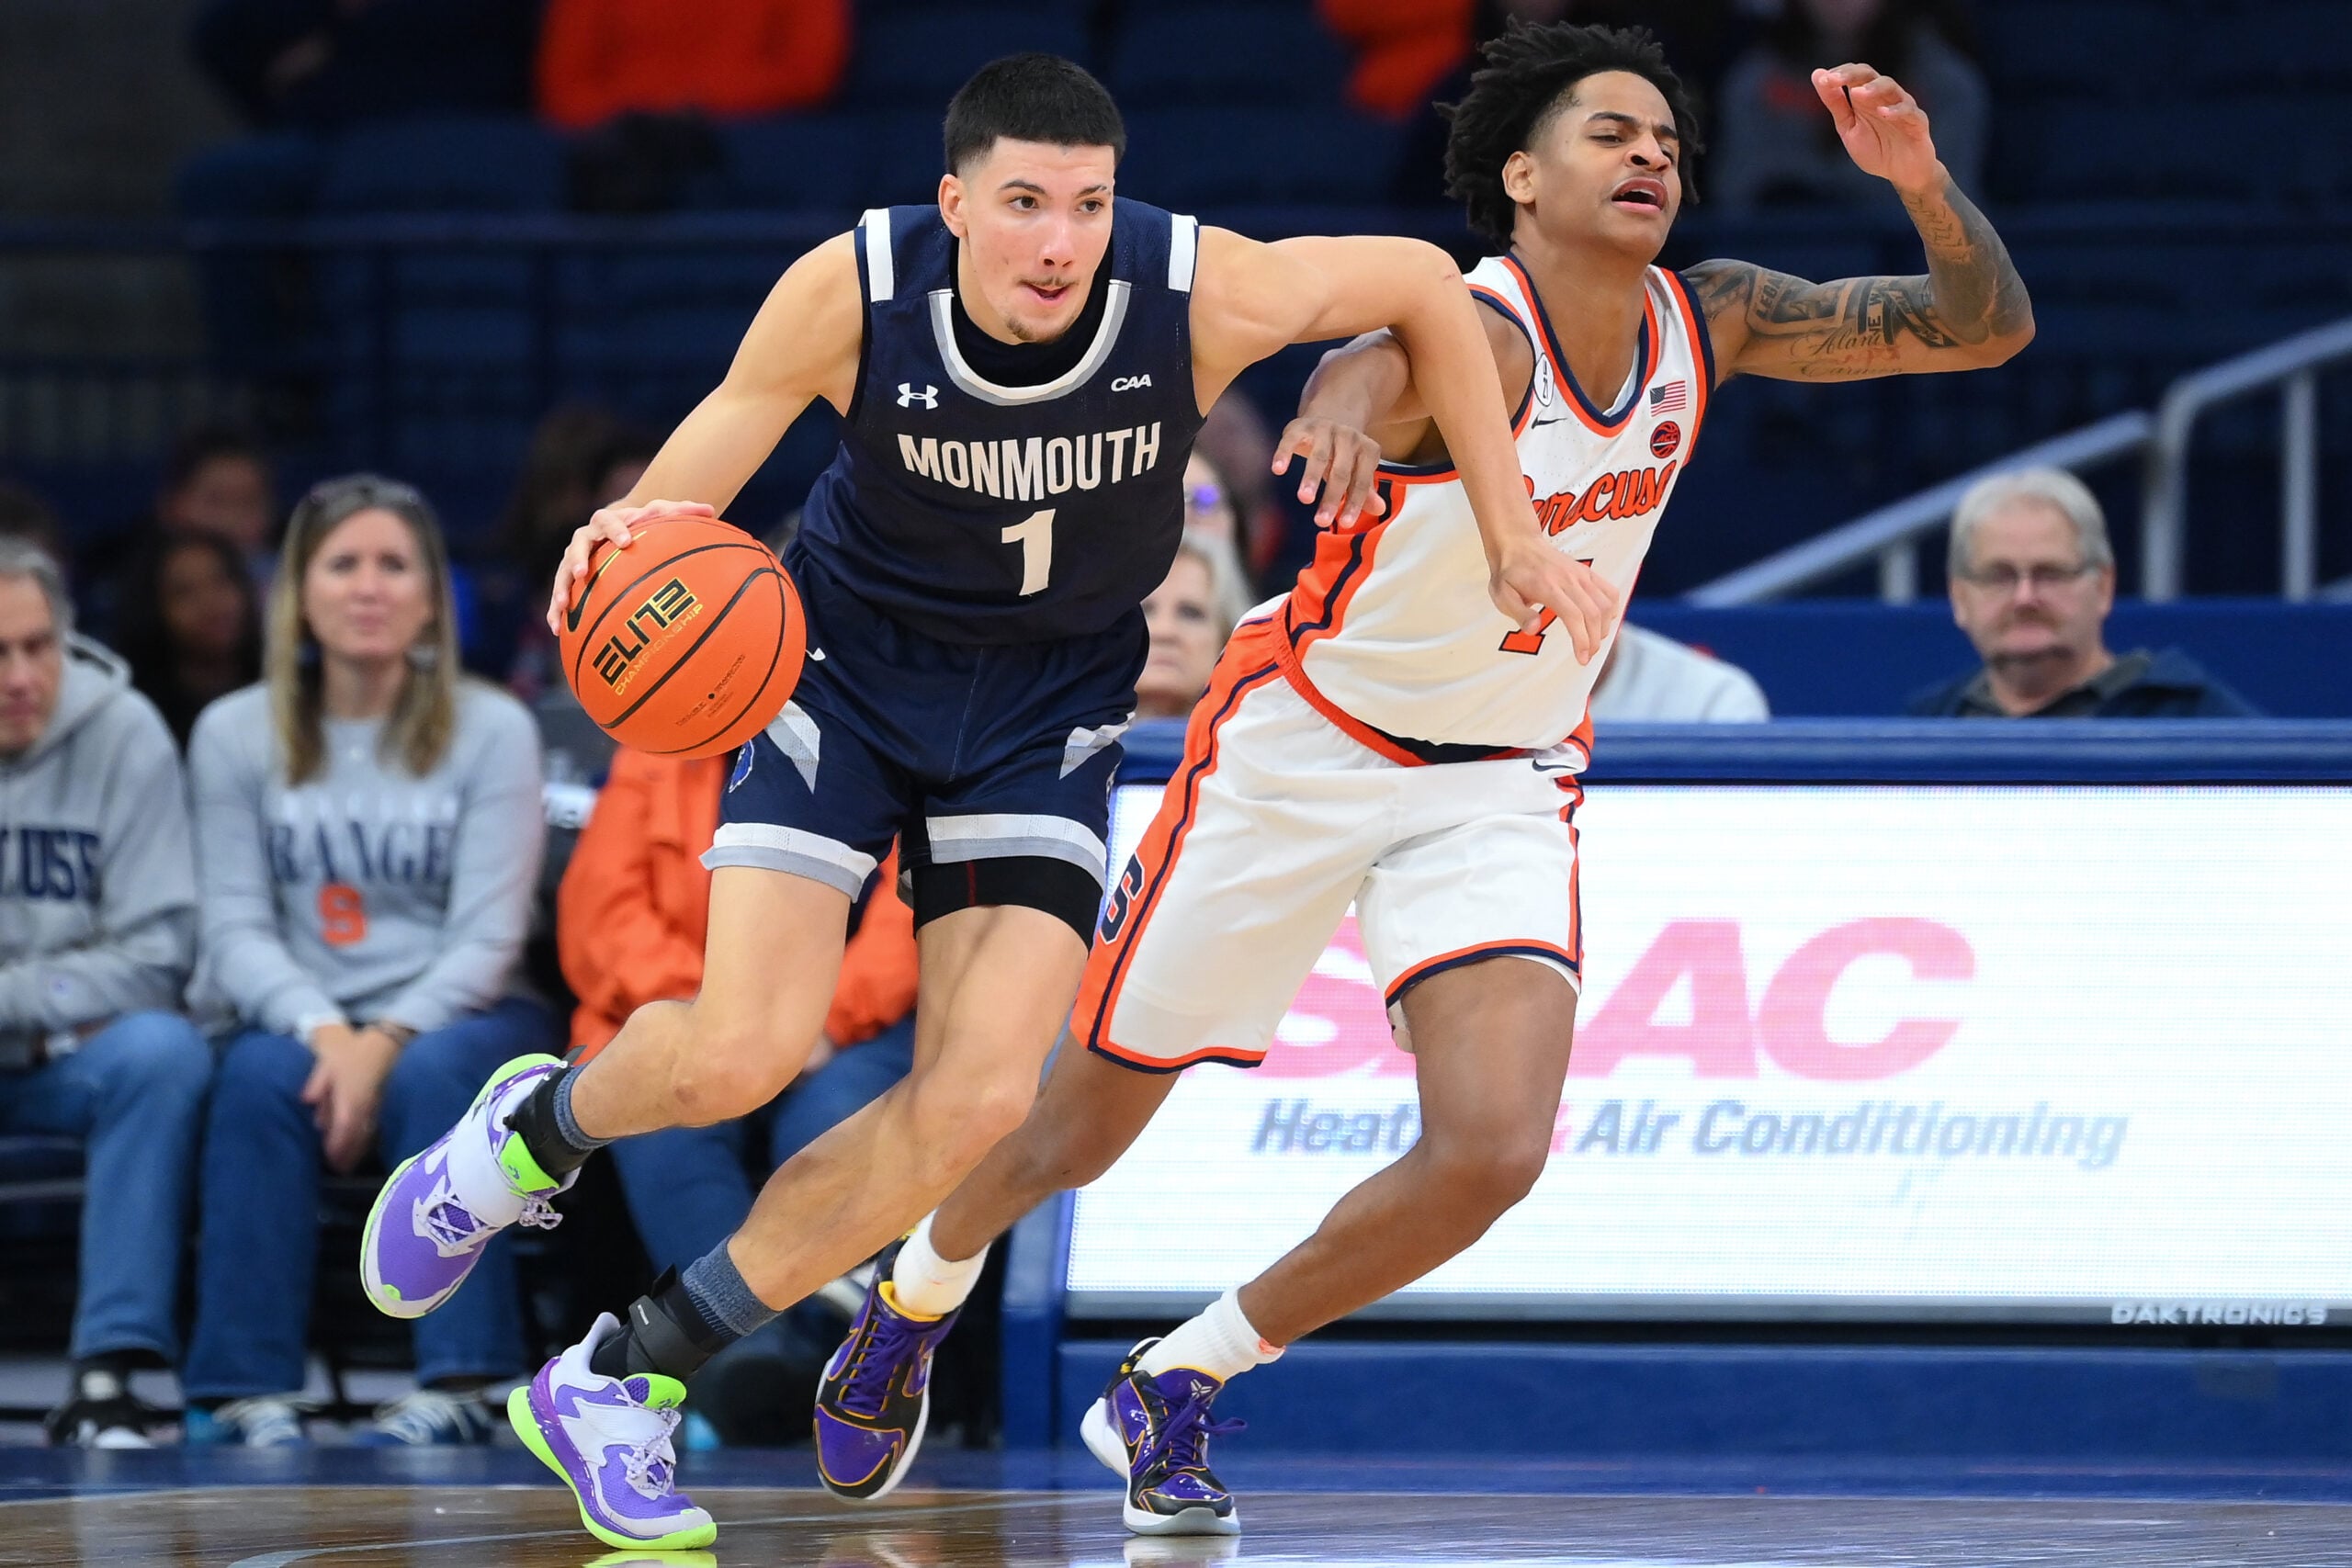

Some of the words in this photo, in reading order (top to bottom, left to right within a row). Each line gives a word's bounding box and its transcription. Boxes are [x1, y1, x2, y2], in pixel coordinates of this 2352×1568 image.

[1111, 374, 1152, 392] CAA
[897, 422, 1161, 502] MONMOUTH
[1001, 508, 1056, 596] 1
[592, 577, 698, 687] ELITE
[615, 604, 704, 696] CHAMPIONSHIP
[317, 883, 368, 947] S
[1250, 1098, 1422, 1154] Heat
[1575, 1100, 1680, 1154] Air
[1694, 1099, 2130, 1170] Conditioning
[2111, 1302, 2327, 1325] DAKTRONICS
